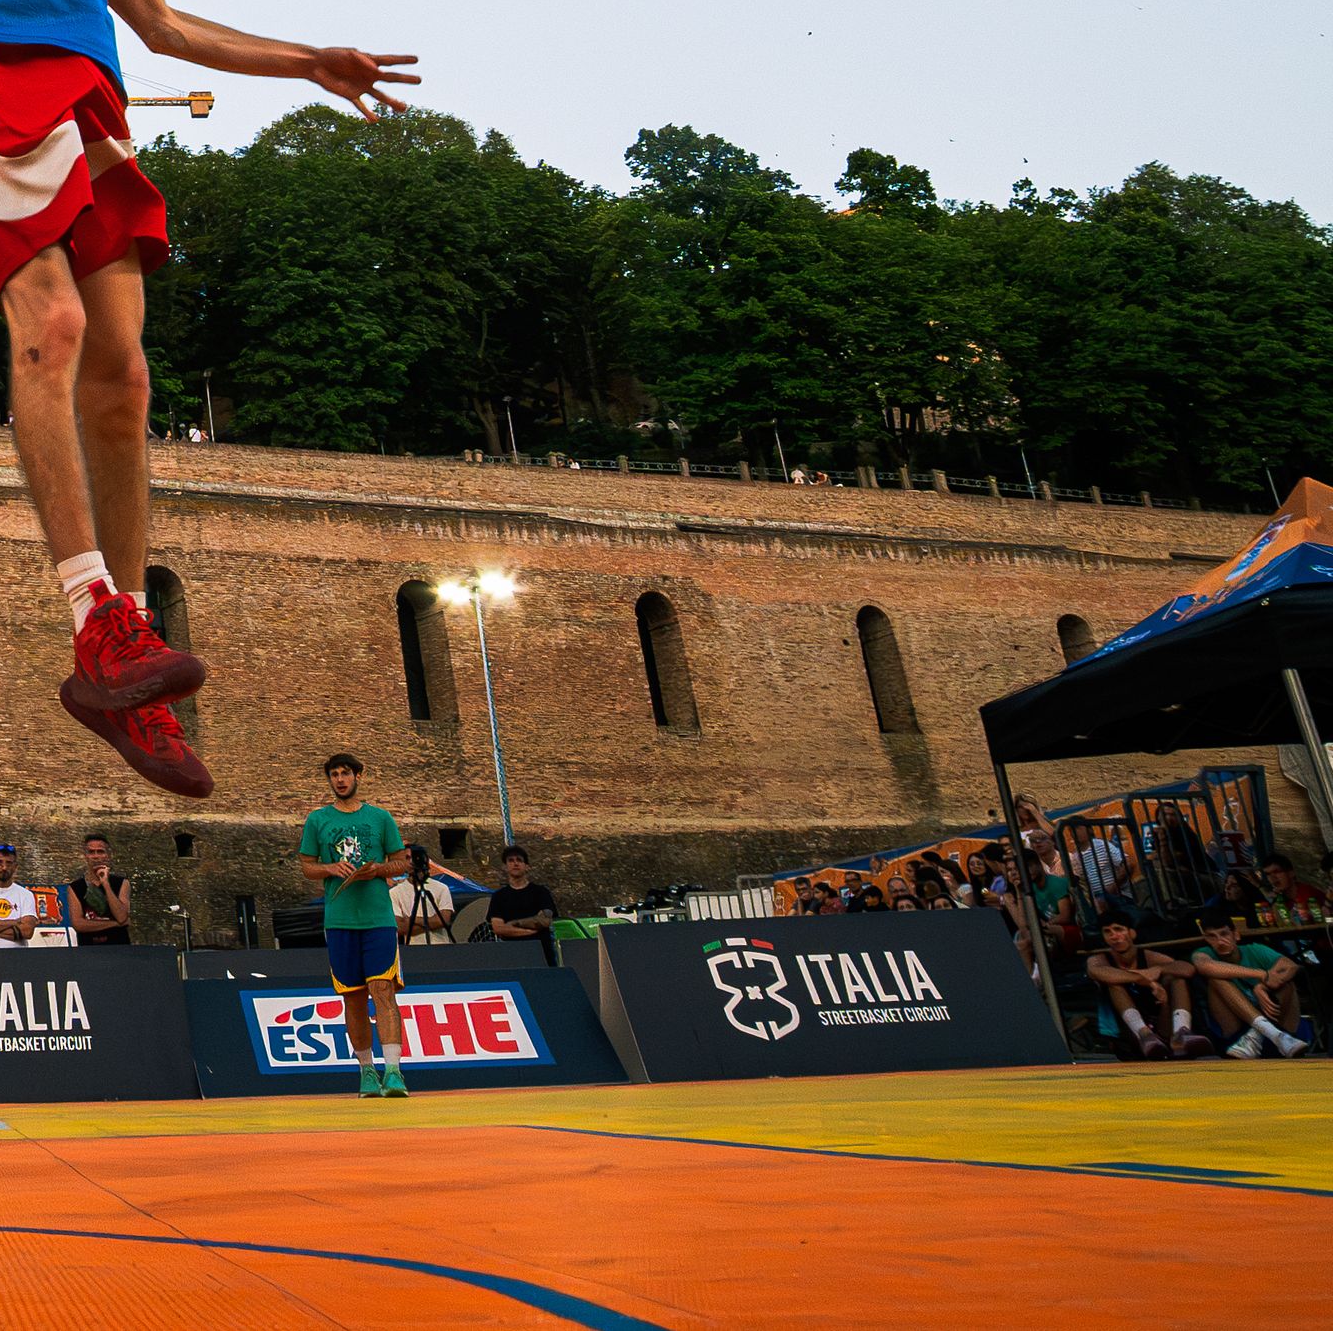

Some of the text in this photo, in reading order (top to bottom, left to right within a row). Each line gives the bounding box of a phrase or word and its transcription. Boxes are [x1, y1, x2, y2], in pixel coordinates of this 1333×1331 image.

[795, 950, 943, 1005] ITALIA
[818, 1005, 951, 1026] STREETBASKET CIRCUIT
[48, 1035, 92, 1051] CIRCUIT
